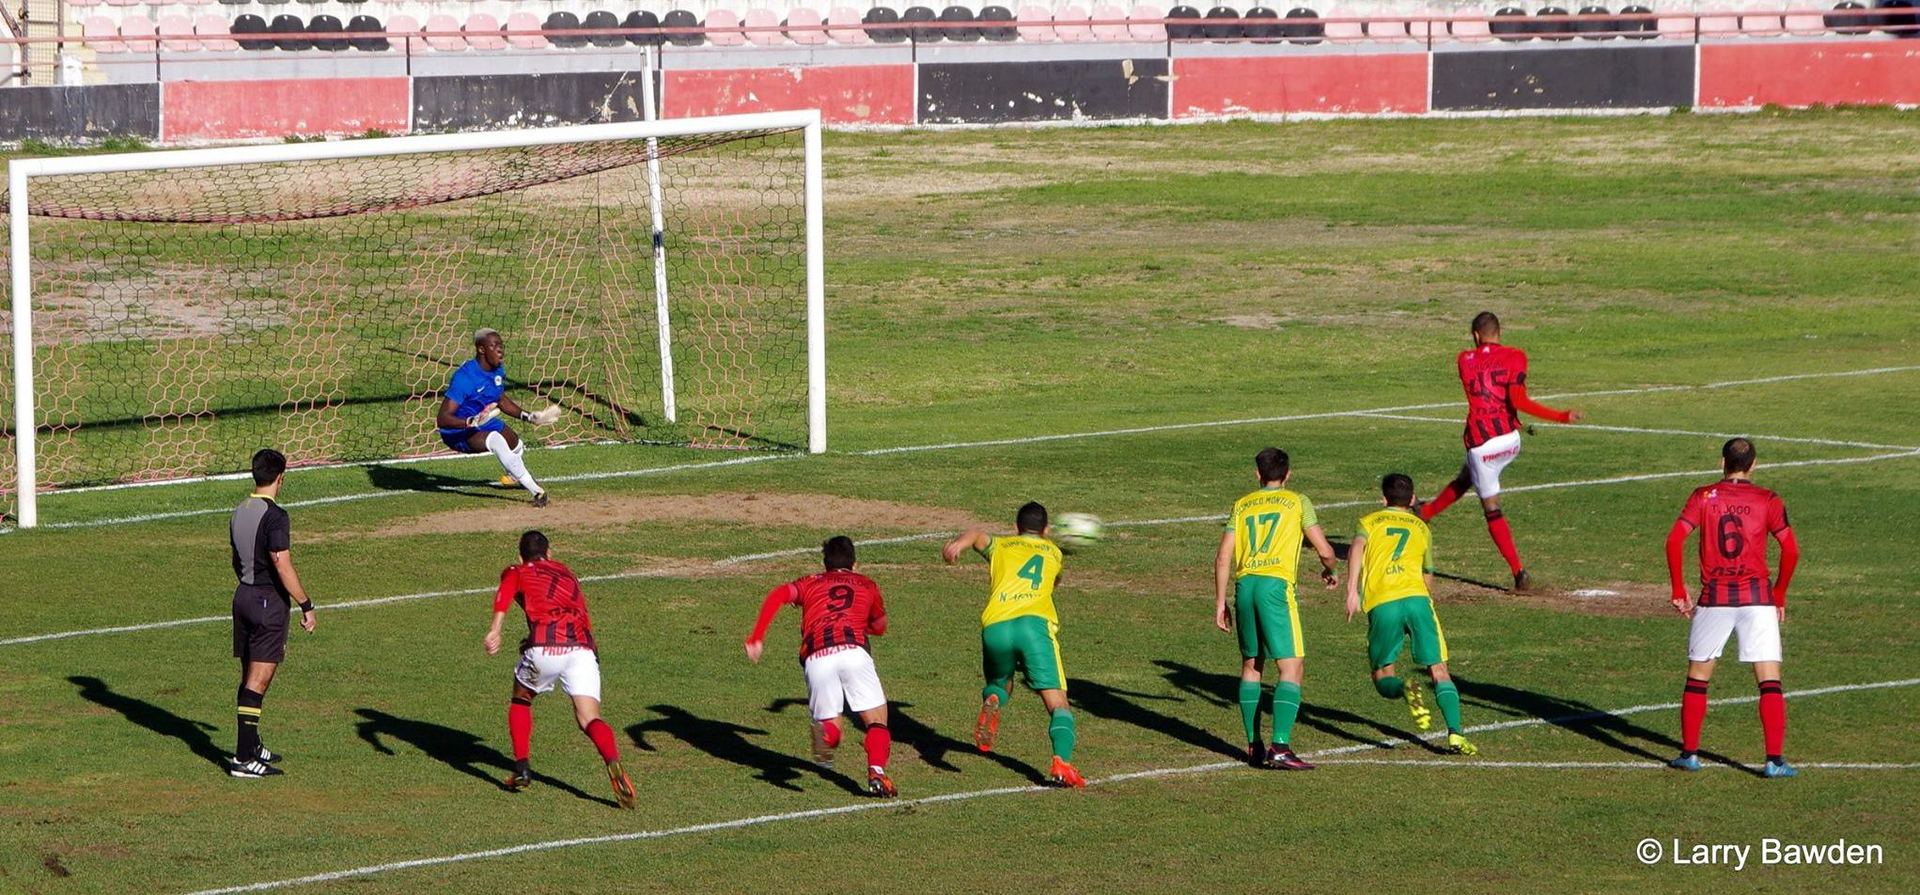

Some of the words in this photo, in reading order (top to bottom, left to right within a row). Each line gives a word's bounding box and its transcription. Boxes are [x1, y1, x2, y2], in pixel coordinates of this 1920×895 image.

[1245, 512, 1281, 557] 17
[1386, 527, 1411, 561] 7
[1717, 514, 1744, 560] 6
[1016, 553, 1045, 591] 4
[826, 584, 856, 613] 9
